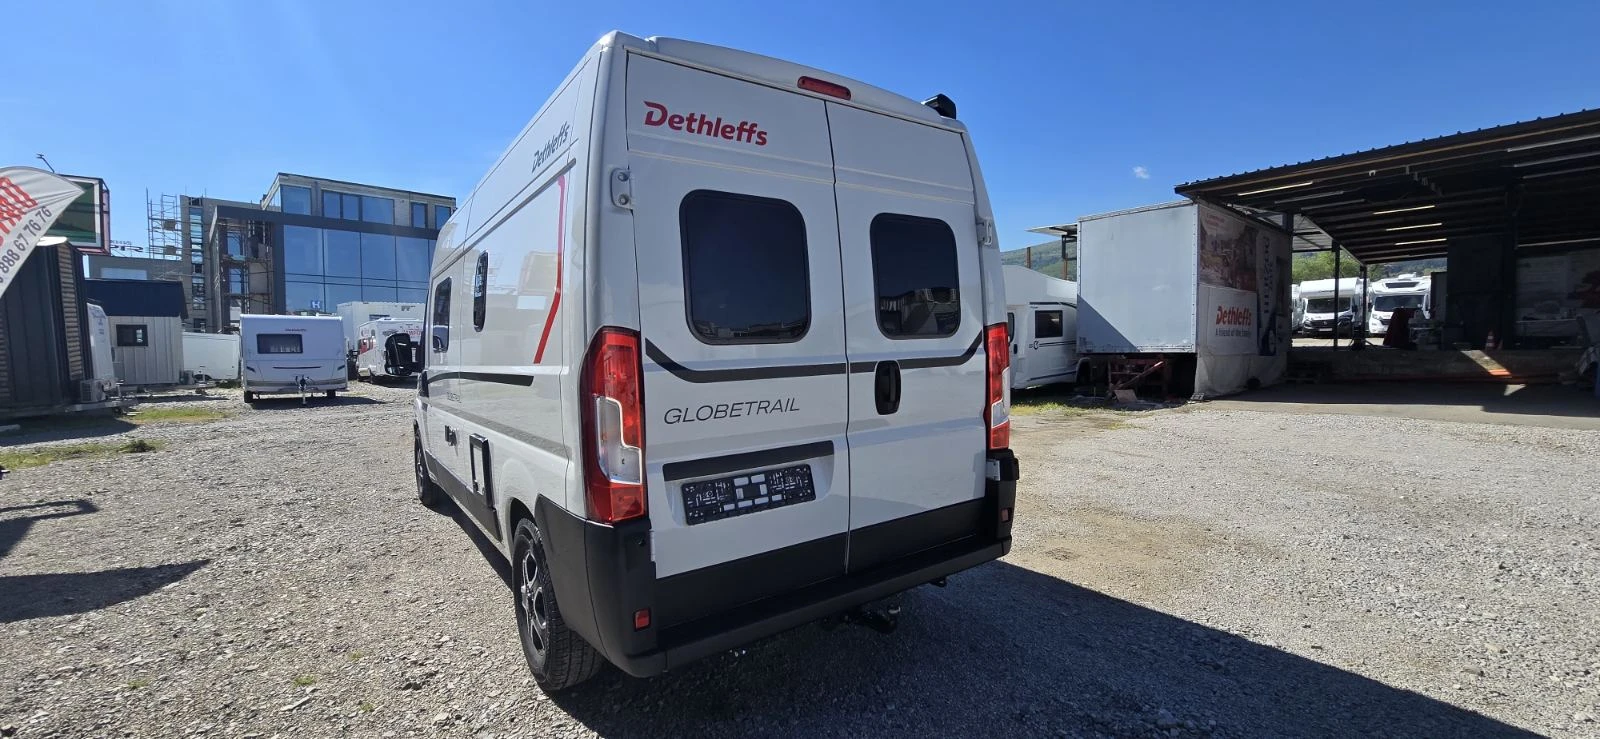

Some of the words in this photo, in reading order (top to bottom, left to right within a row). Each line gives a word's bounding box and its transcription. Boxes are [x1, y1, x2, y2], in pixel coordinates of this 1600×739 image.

[644, 101, 768, 146] Dethleffs
[532, 121, 570, 173] Dethleffs
[0, 249, 20, 274] 888
[13, 233, 29, 252] 67
[23, 219, 42, 237] 76
[35, 205, 52, 223] 76
[1215, 305, 1252, 326] Dethleffs
[664, 398, 800, 425] GLOBETRAIL
